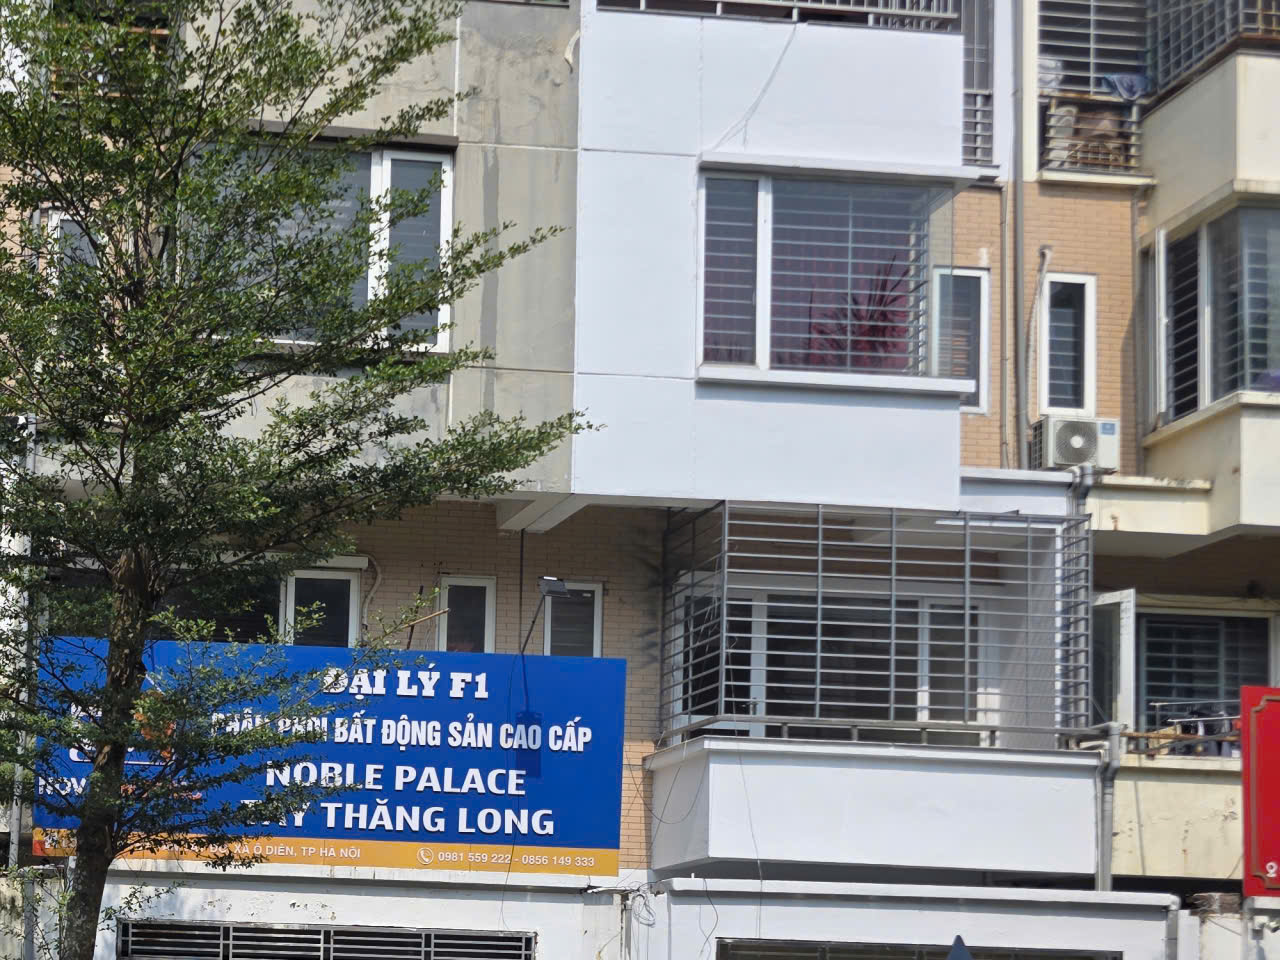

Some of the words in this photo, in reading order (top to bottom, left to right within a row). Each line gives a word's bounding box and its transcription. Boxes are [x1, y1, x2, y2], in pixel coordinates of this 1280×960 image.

[396, 663, 441, 697] LÝ
[449, 672, 489, 699] F1
[334, 709, 377, 745] BẤT
[381, 714, 441, 751] ĐỘNG
[447, 712, 493, 749] SẢN
[499, 722, 542, 750] CAO
[548, 716, 593, 752] CẤP
[266, 760, 384, 790] NOBLE
[395, 765, 527, 796] PALACE
[320, 798, 446, 832] THĂNG
[458, 807, 555, 835] LONG
[301, 847, 316, 857] TP
[339, 847, 361, 859] NỘI
[438, 852, 464, 862] 0981
[468, 853, 488, 863] 559
[490, 854, 511, 864] 222
[522, 854, 548, 865] 0856
[552, 856, 571, 866] 149
[575, 857, 595, 867] 333
